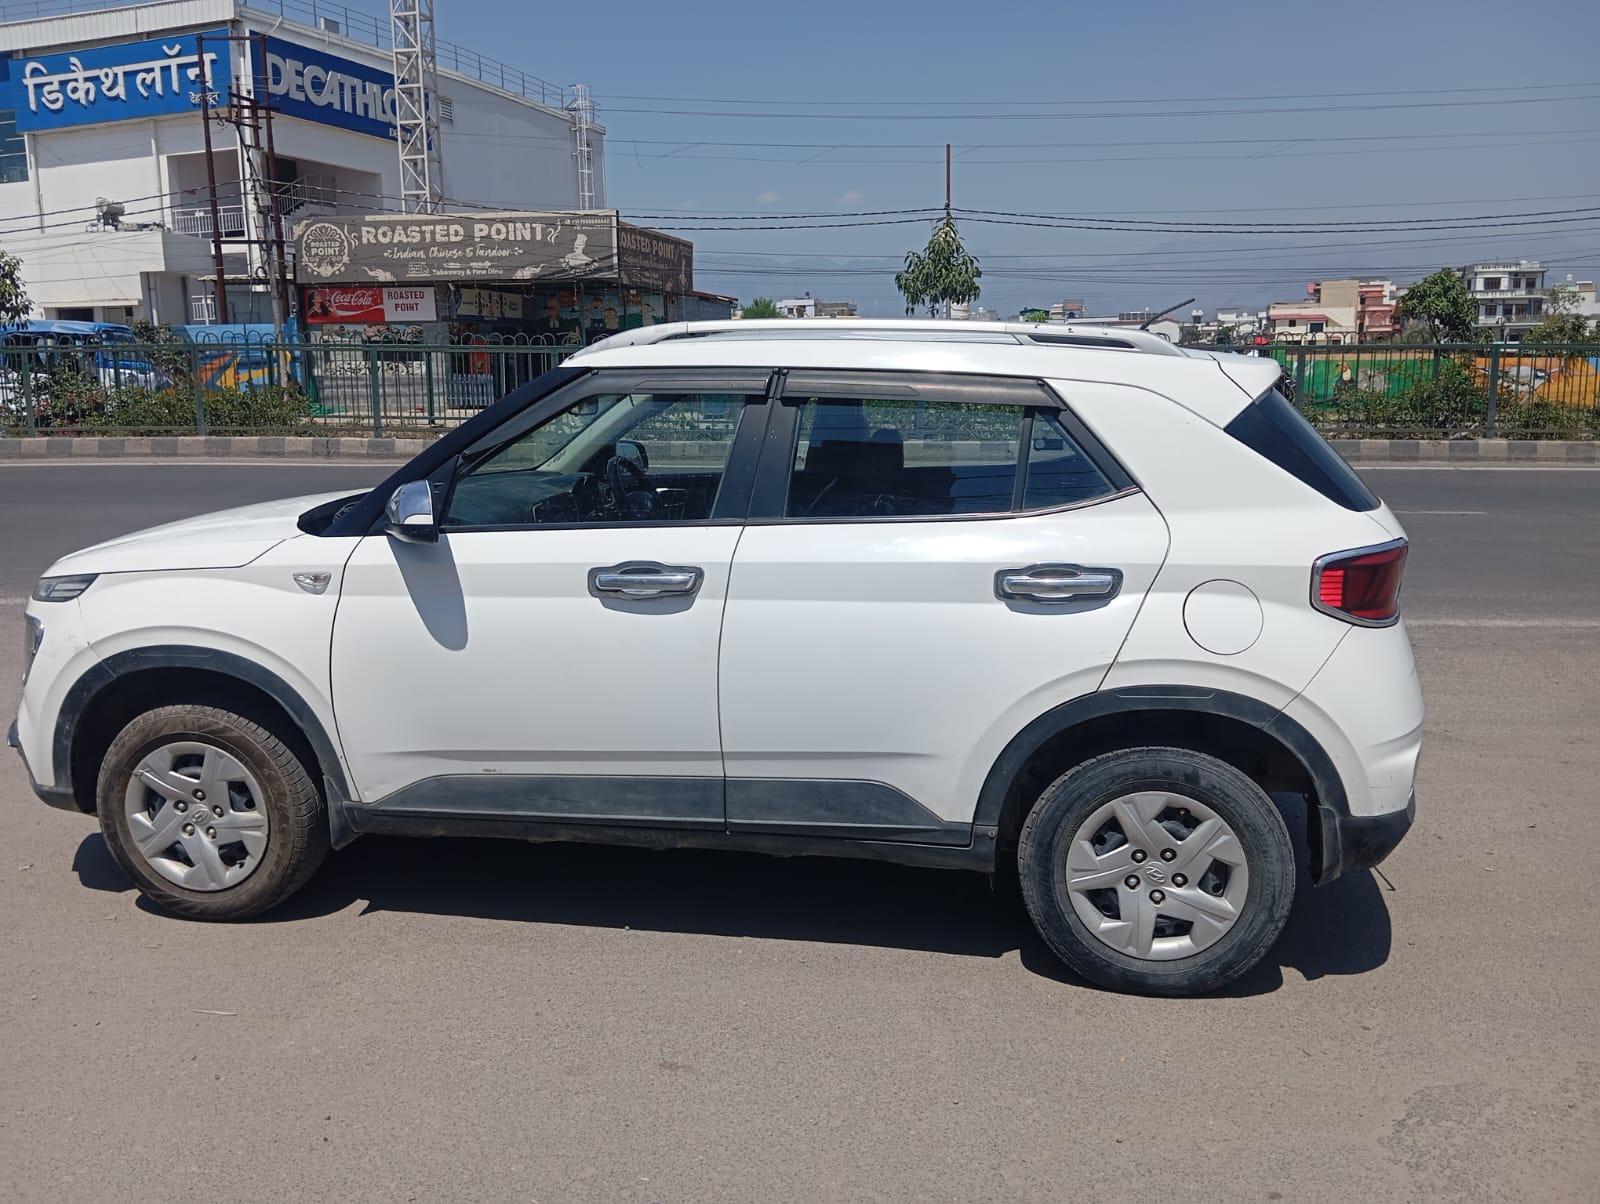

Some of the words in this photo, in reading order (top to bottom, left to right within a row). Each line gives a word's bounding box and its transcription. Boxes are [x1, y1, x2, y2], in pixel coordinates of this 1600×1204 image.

[22, 44, 218, 112] डिकैथलॉन
[361, 225, 464, 244] ROASTED
[474, 223, 545, 241] POINT
[311, 247, 340, 255] POINT
[429, 246, 463, 258] Chinese
[475, 244, 511, 257] Tandoor
[620, 231, 651, 253] OASTED
[651, 240, 674, 259] POINT
[387, 290, 424, 300] ROASTED
[395, 303, 420, 311] POINT
